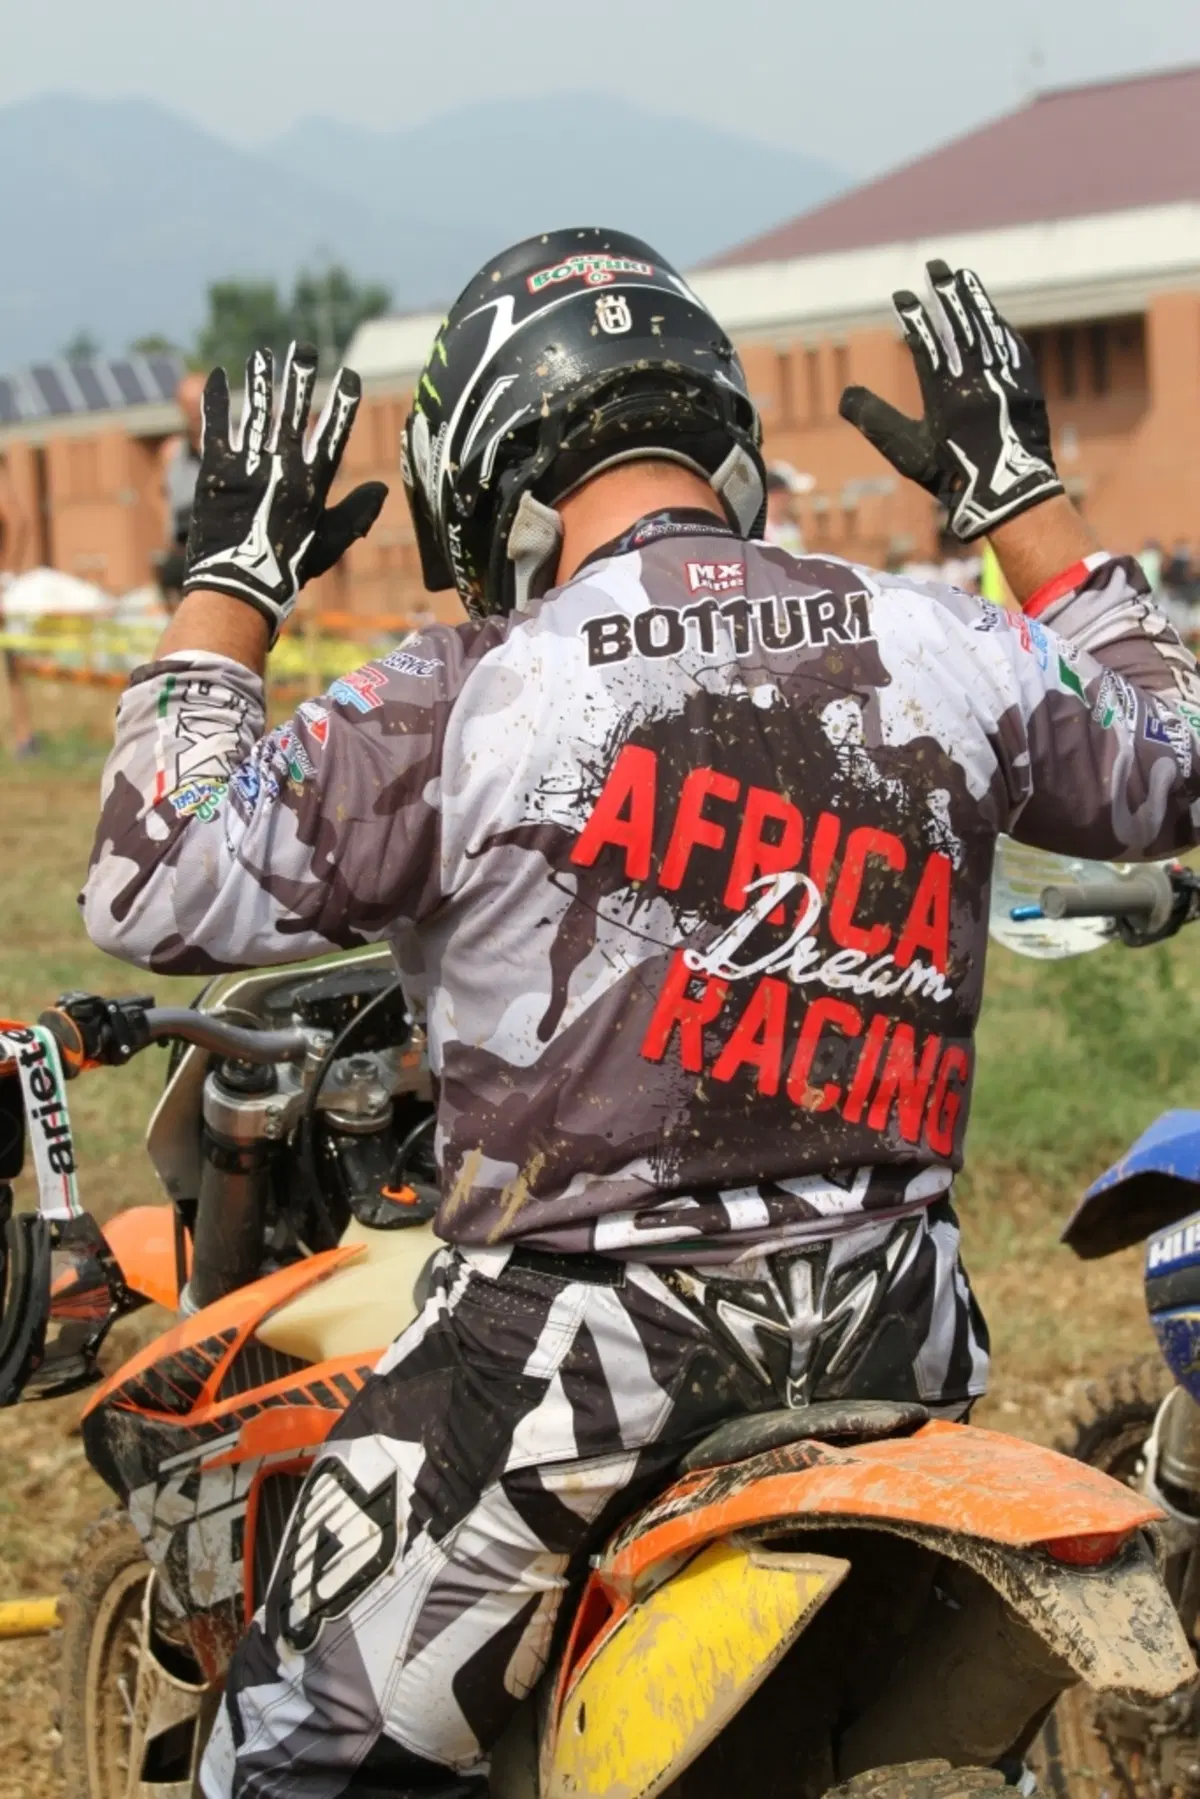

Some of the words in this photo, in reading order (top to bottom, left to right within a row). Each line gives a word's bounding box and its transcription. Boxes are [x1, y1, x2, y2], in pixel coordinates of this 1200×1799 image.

[579, 589, 878, 667] BOTTURI
[570, 743, 953, 975] AFRICA
[683, 870, 954, 1002] Dream
[5, 1028, 76, 1175] ariete
[639, 947, 968, 1157] RACING
[1149, 1222, 1200, 1269] HU
